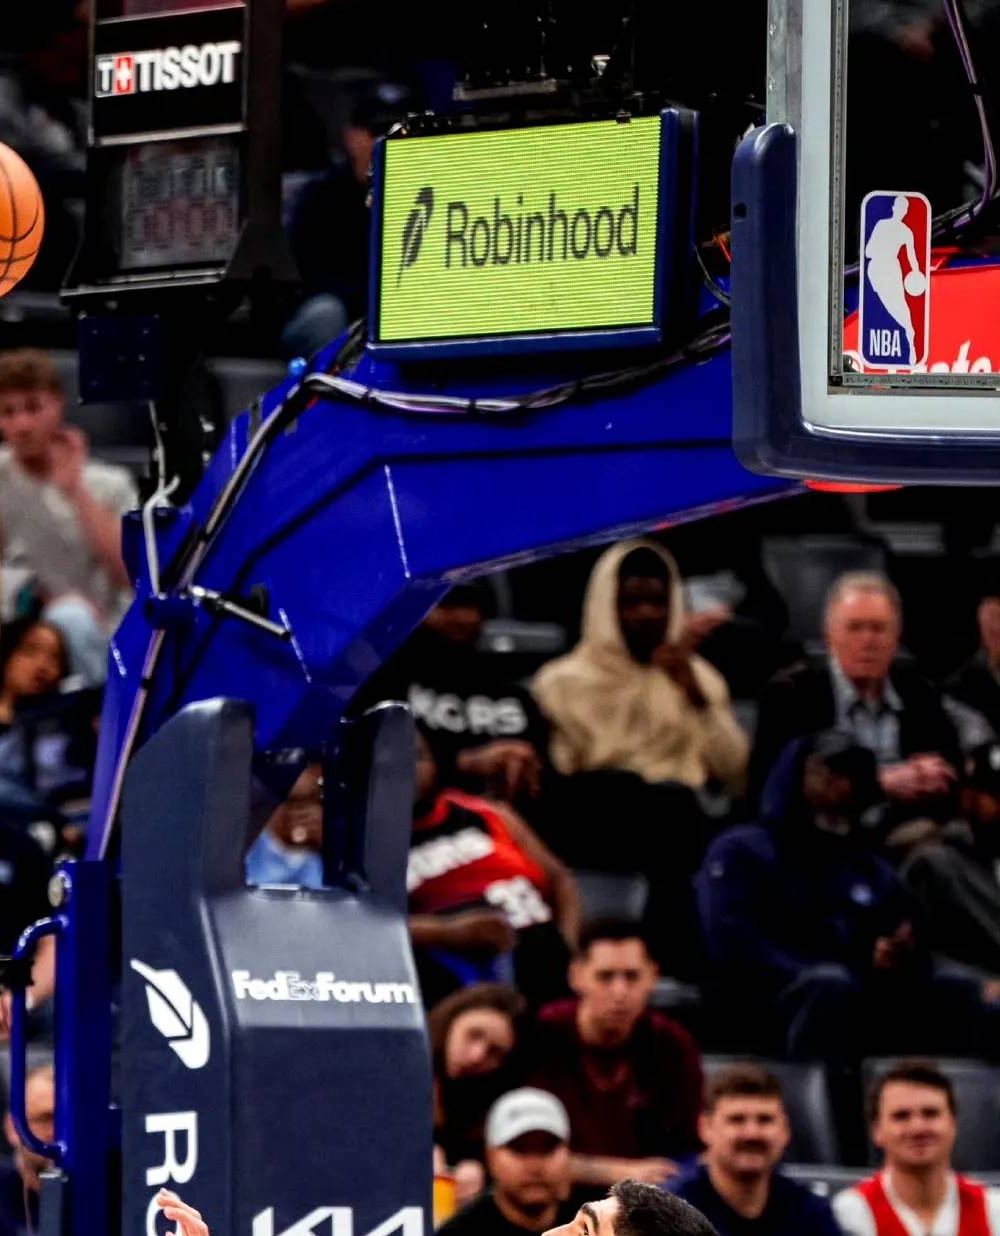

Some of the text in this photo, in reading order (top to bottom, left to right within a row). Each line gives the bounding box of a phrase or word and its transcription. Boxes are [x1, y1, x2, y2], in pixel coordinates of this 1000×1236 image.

[134, 40, 241, 92] TISSOT
[445, 182, 639, 268] Robinhood
[869, 329, 901, 357] NBA
[231, 970, 415, 1003] FedExForum
